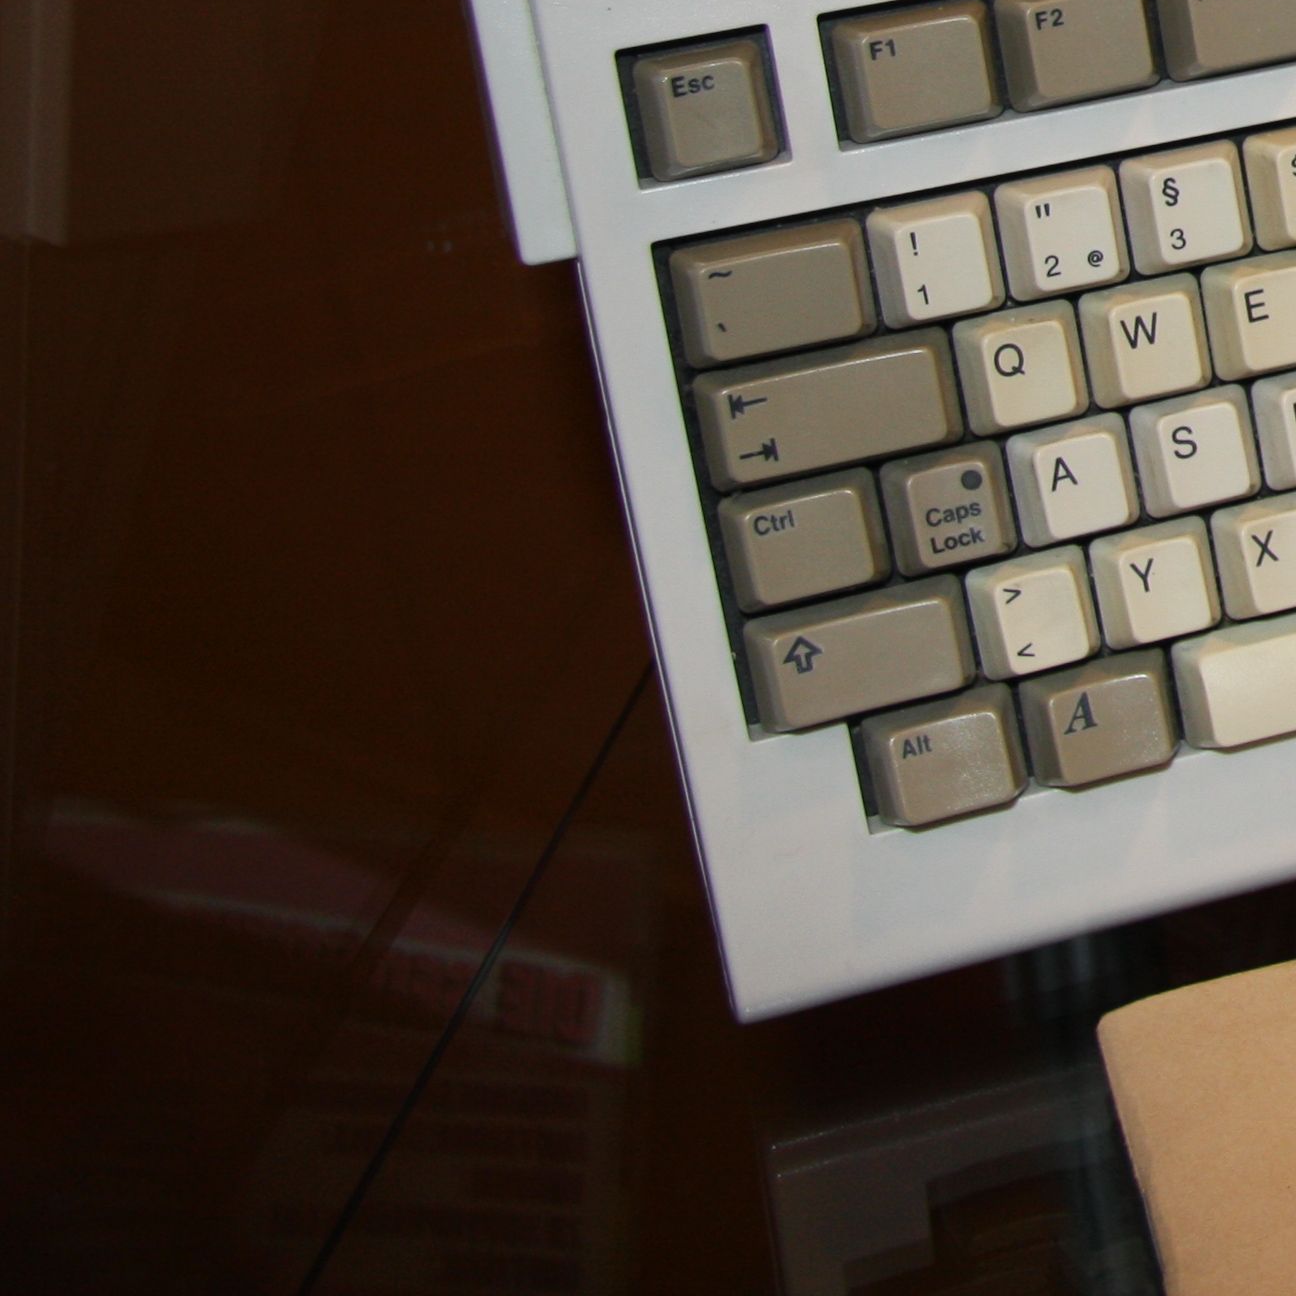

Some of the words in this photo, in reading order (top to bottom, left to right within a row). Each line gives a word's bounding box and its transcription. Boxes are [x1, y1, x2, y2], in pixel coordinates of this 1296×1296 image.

[1035, 9, 1065, 32] F2
[870, 38, 898, 62] F1
[671, 73, 715, 98] Esc
[1171, 228, 1187, 251] 3
[1044, 255, 1062, 278] 2
[917, 284, 930, 306] 1
[1244, 289, 1270, 324] E
[1120, 312, 1159, 349] W
[994, 343, 1026, 378] Q
[1171, 426, 1198, 460] S
[1050, 457, 1079, 492] A
[753, 509, 796, 537] Ctrl
[925, 500, 982, 529] Caps
[931, 525, 985, 555] Lock
[1250, 530, 1280, 567] X
[1130, 558, 1156, 593] Y
[902, 734, 933, 760] Alt
